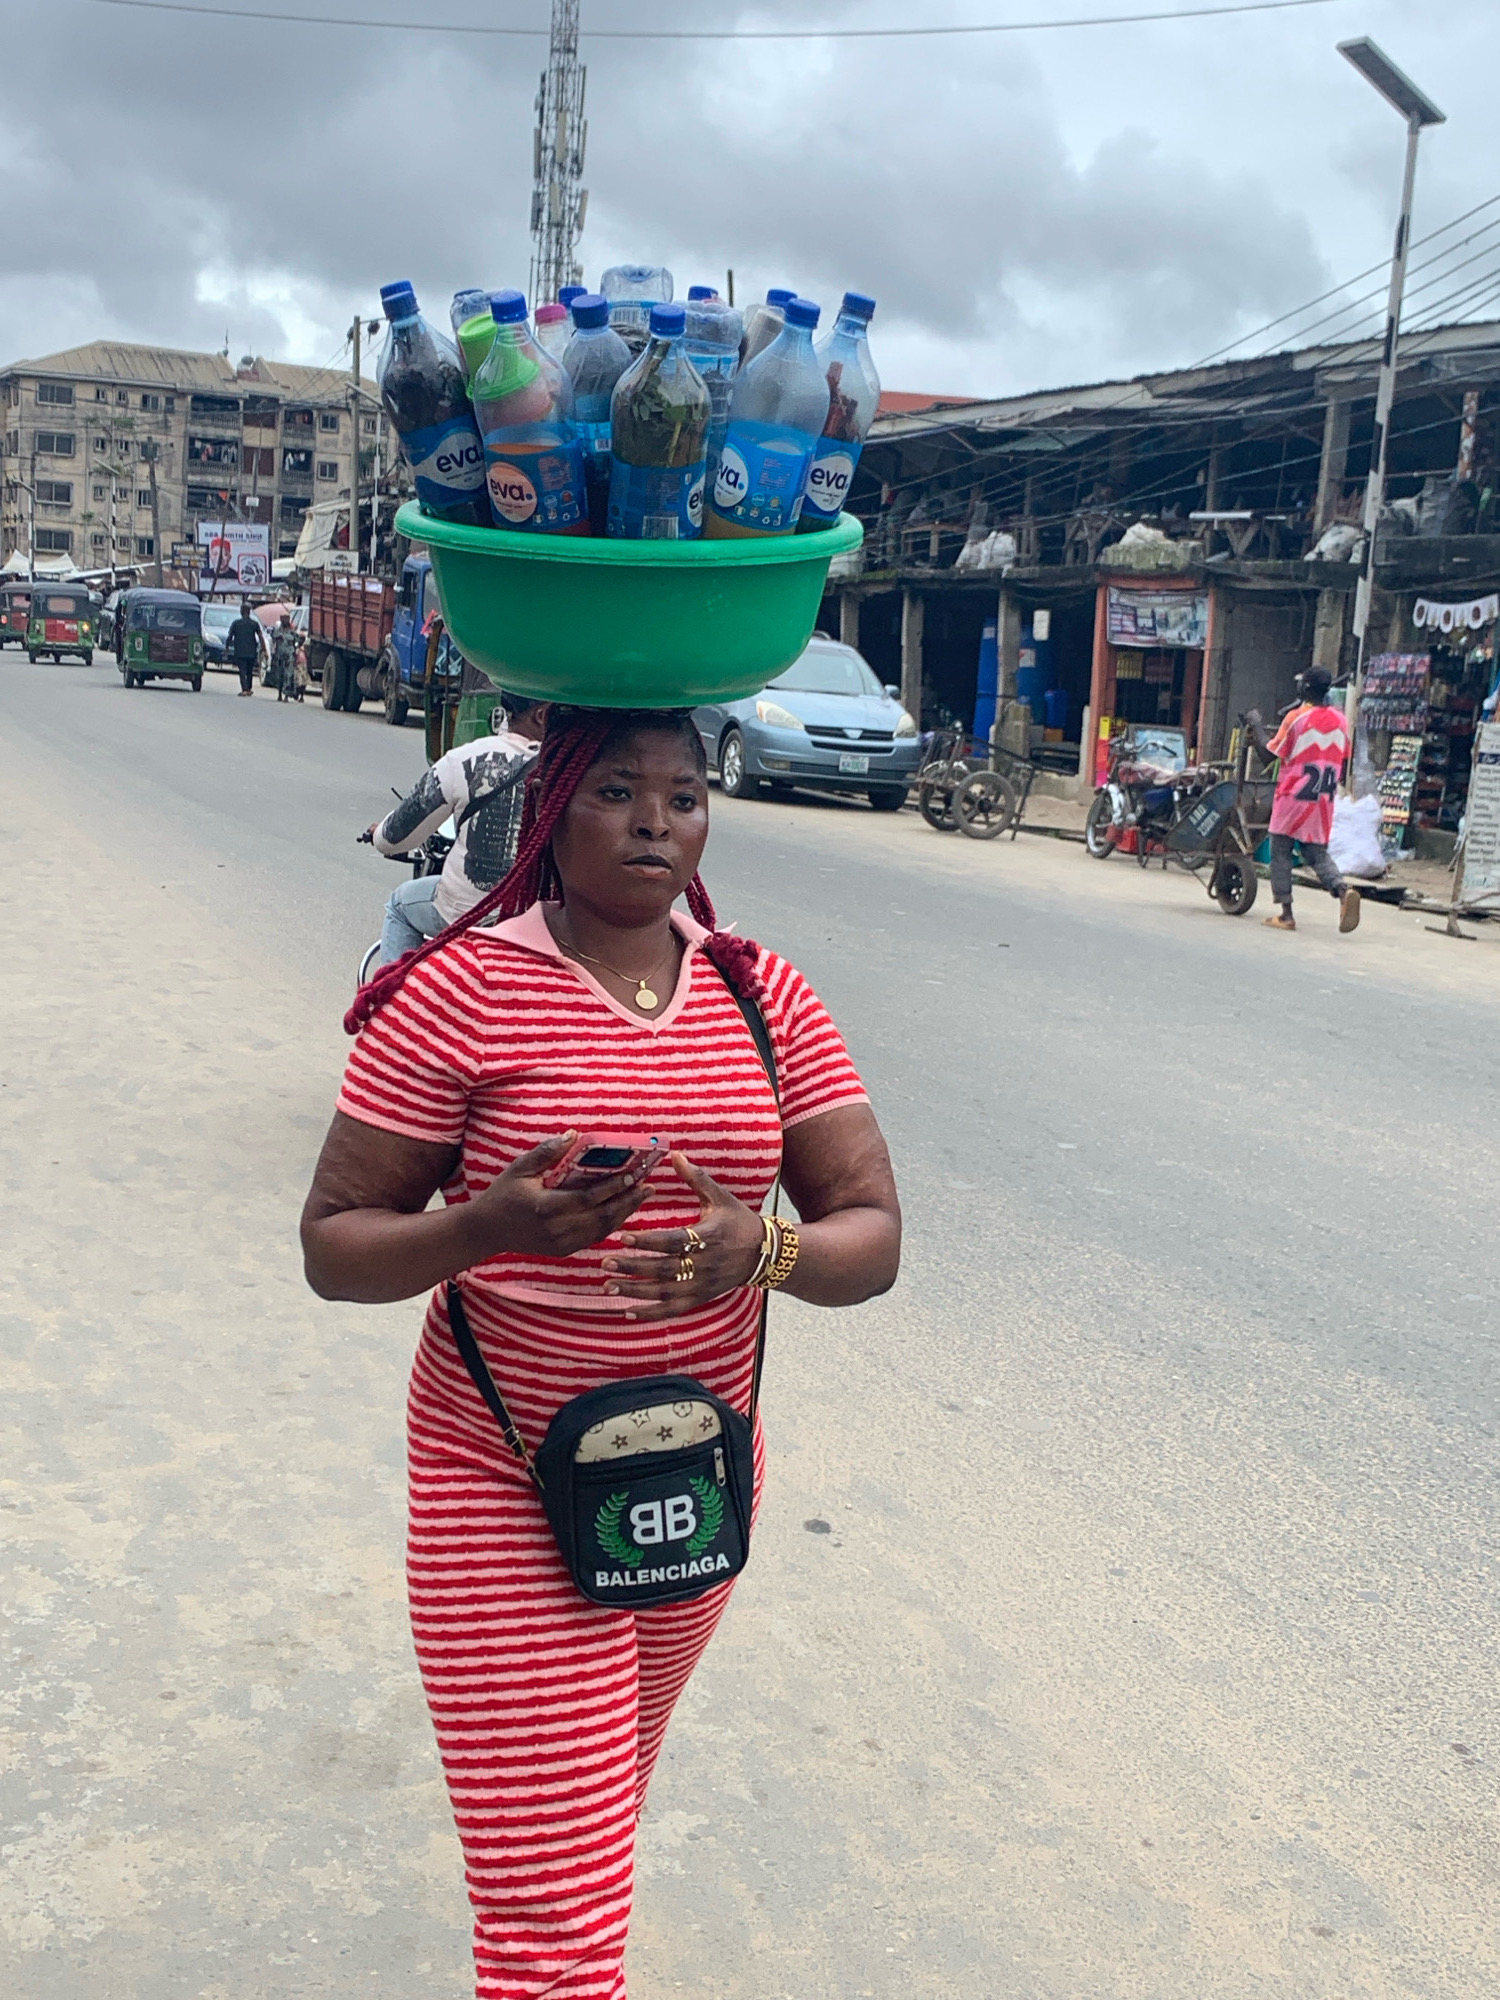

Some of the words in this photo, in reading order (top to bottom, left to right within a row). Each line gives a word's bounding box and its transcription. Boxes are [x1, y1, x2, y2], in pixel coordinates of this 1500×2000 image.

[436, 445, 481, 473] eva
[489, 479, 526, 501] eva
[810, 468, 848, 490] eva
[1295, 762, 1337, 803] 24
[595, 1553, 731, 1588] BALENCIAGA
